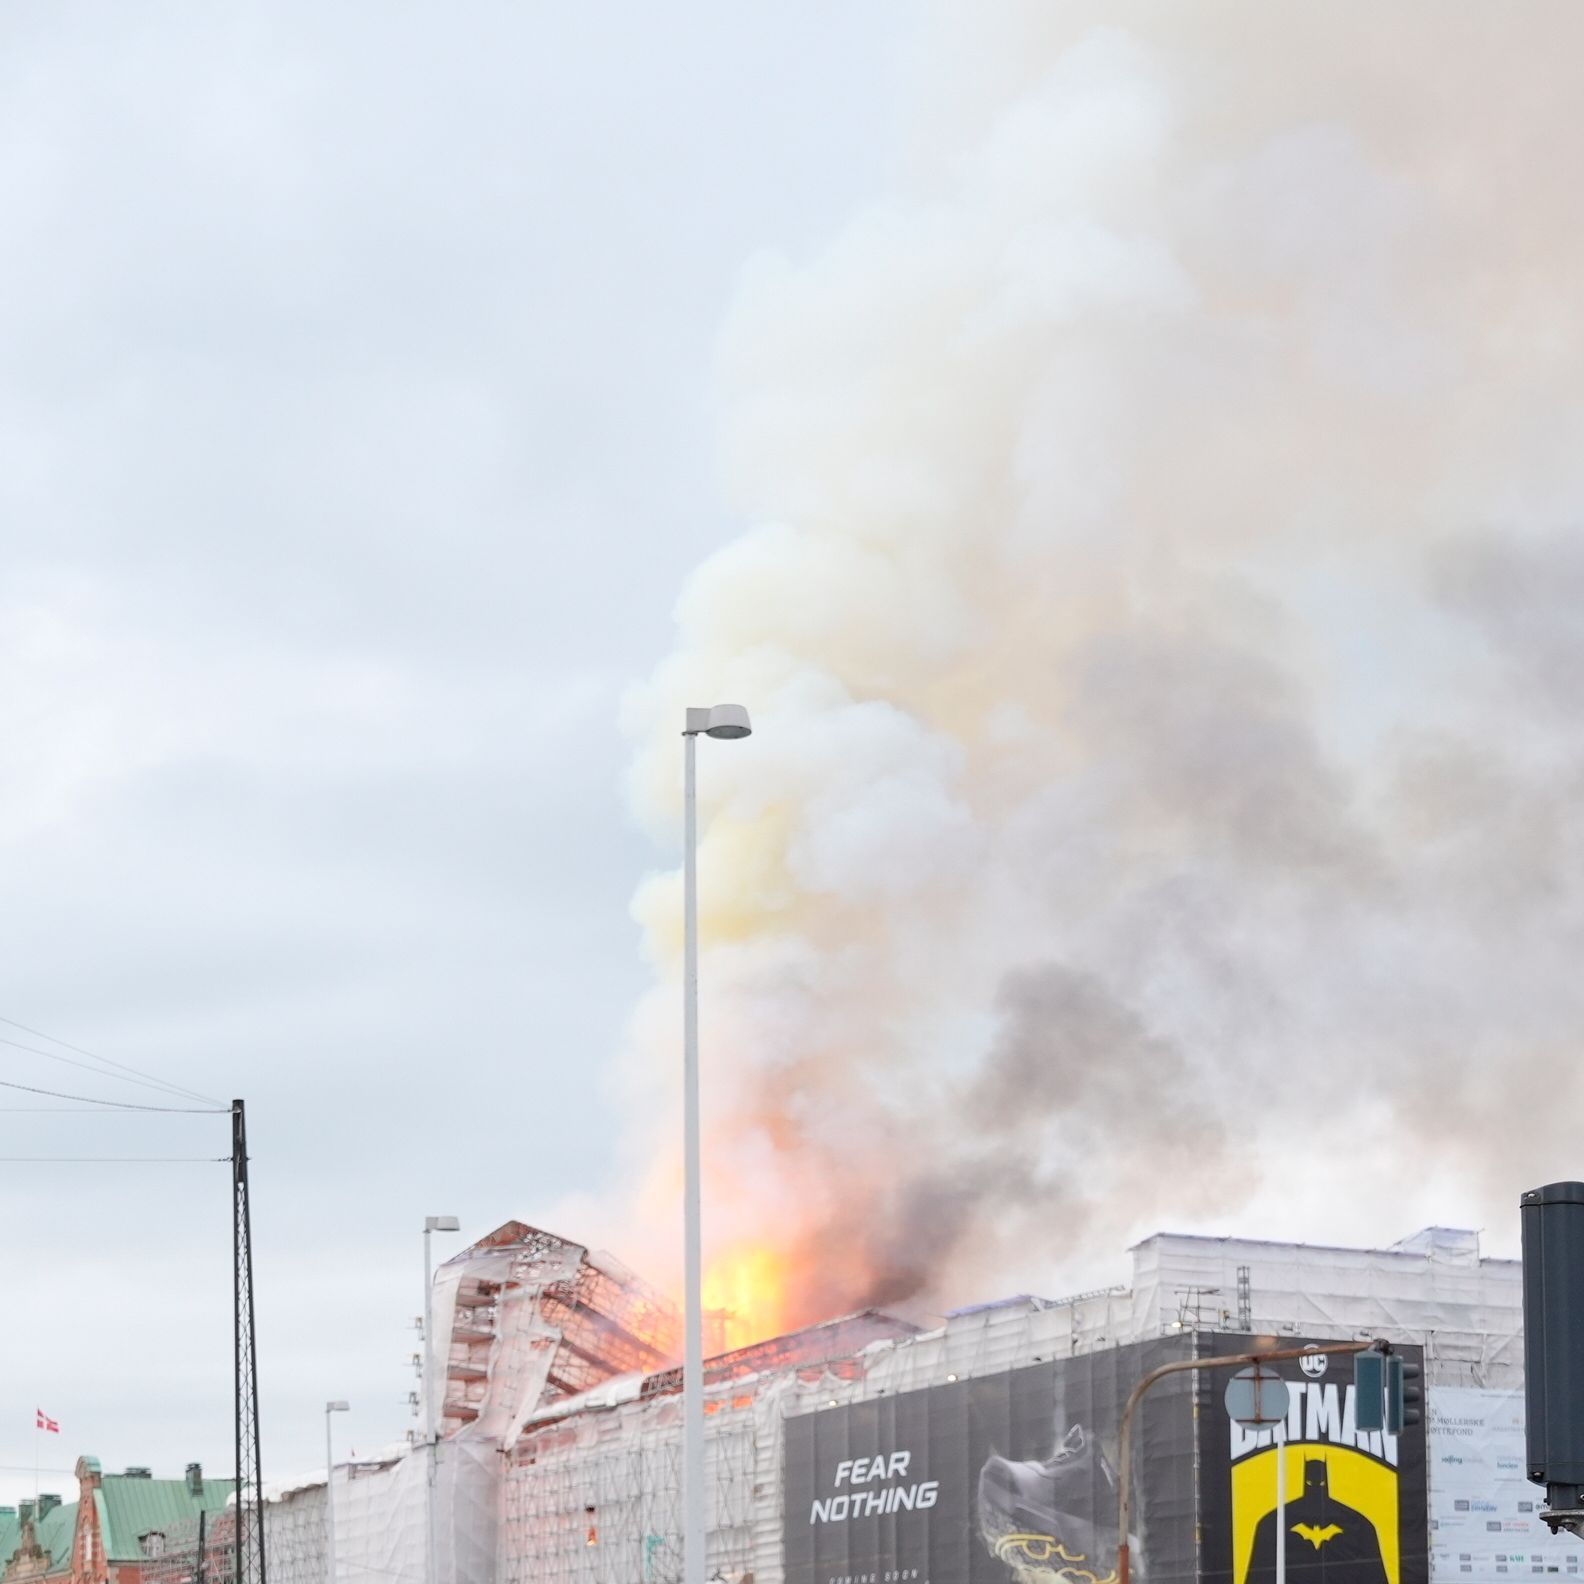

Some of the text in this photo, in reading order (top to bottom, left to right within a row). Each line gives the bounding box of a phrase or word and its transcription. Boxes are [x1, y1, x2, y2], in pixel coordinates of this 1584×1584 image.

[834, 1450, 911, 1487] FEAR
[810, 1481, 939, 1525] NOTHING
[884, 1568, 919, 1583] SOON
